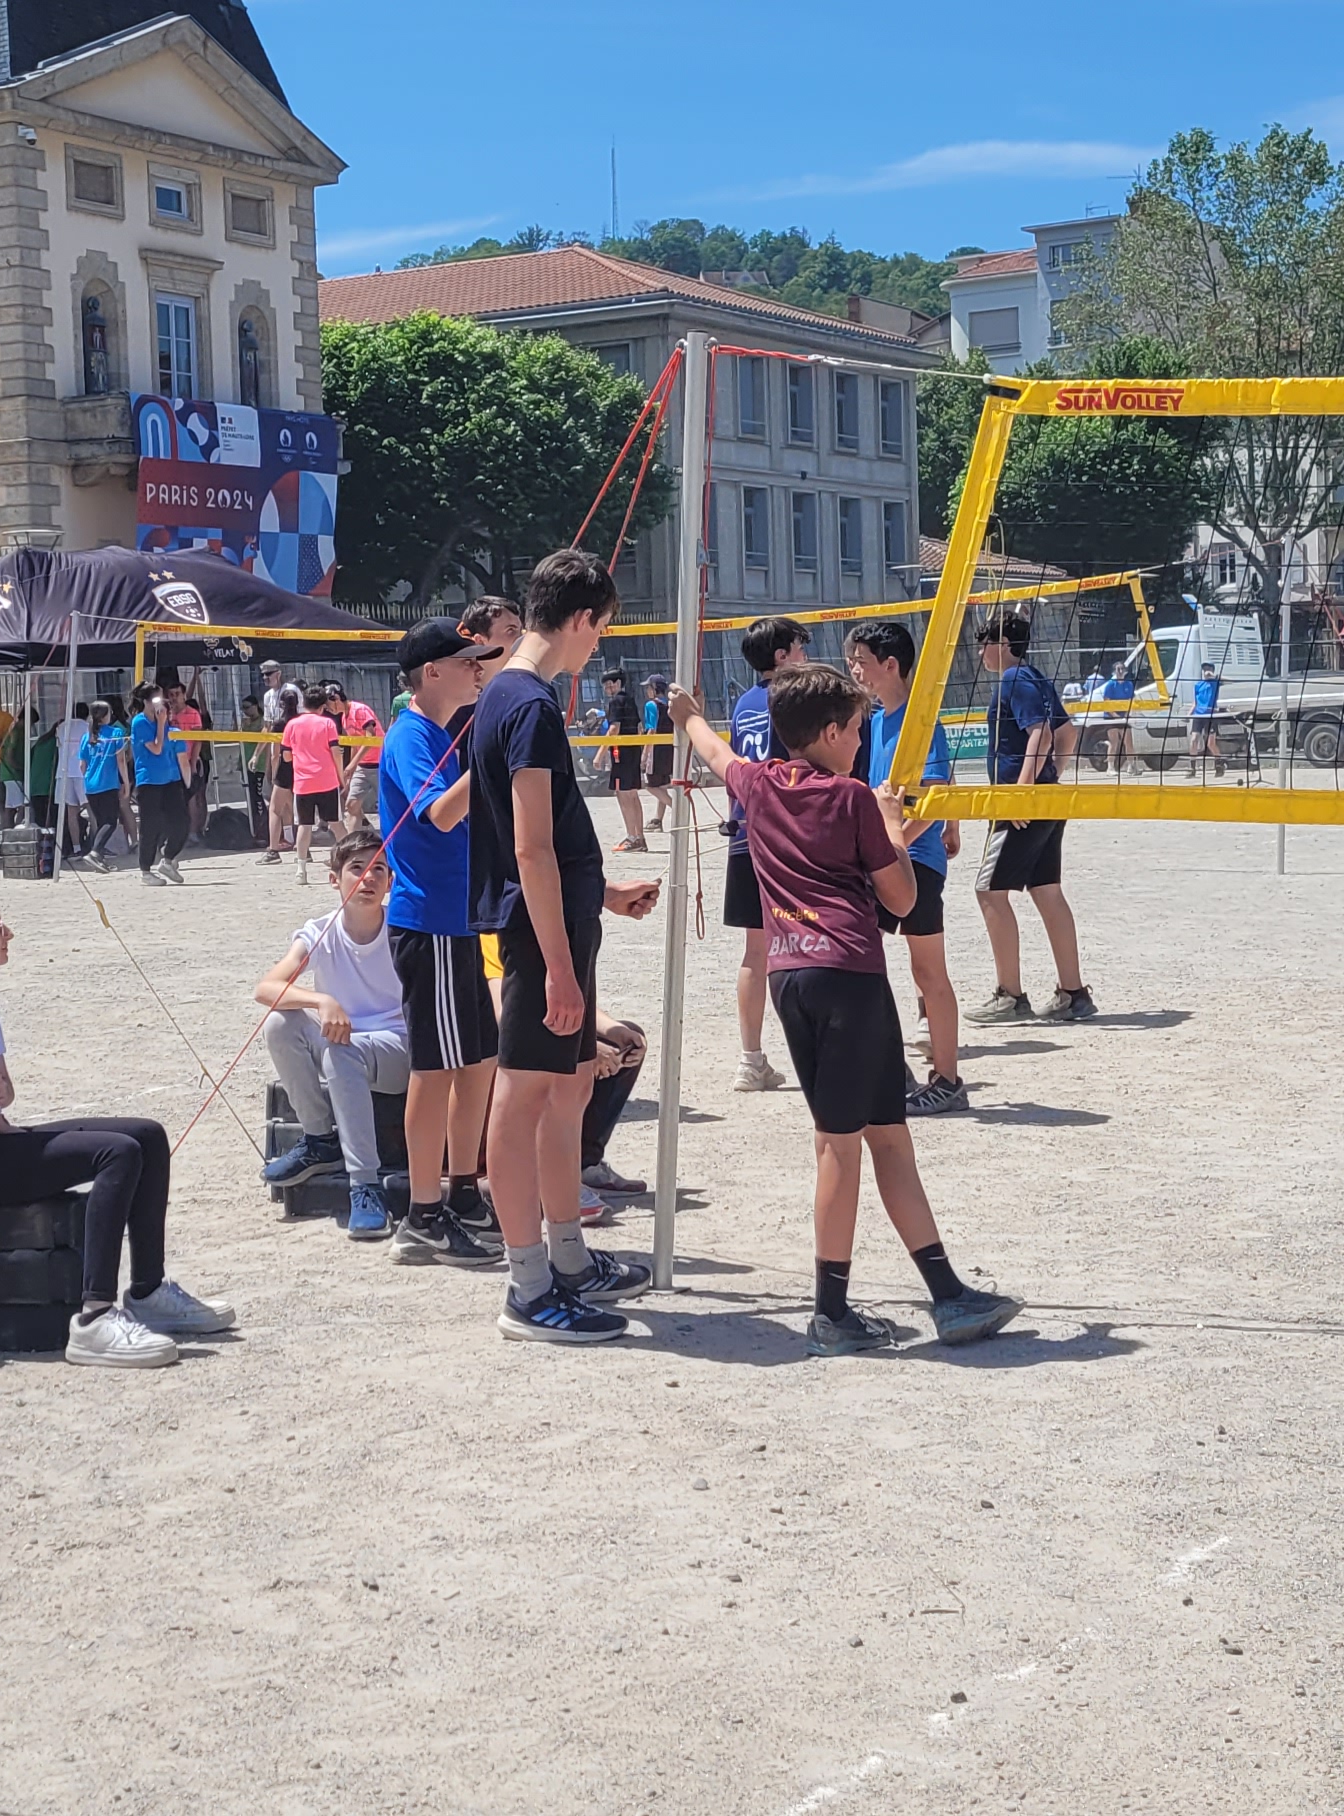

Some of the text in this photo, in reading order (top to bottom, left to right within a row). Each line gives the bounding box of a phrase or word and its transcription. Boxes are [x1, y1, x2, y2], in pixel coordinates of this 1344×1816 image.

[205, 487, 253, 511] 2024
[166, 592, 197, 608] EBSG
[214, 647, 235, 659] VELAY
[768, 932, 831, 957] BARÇA
